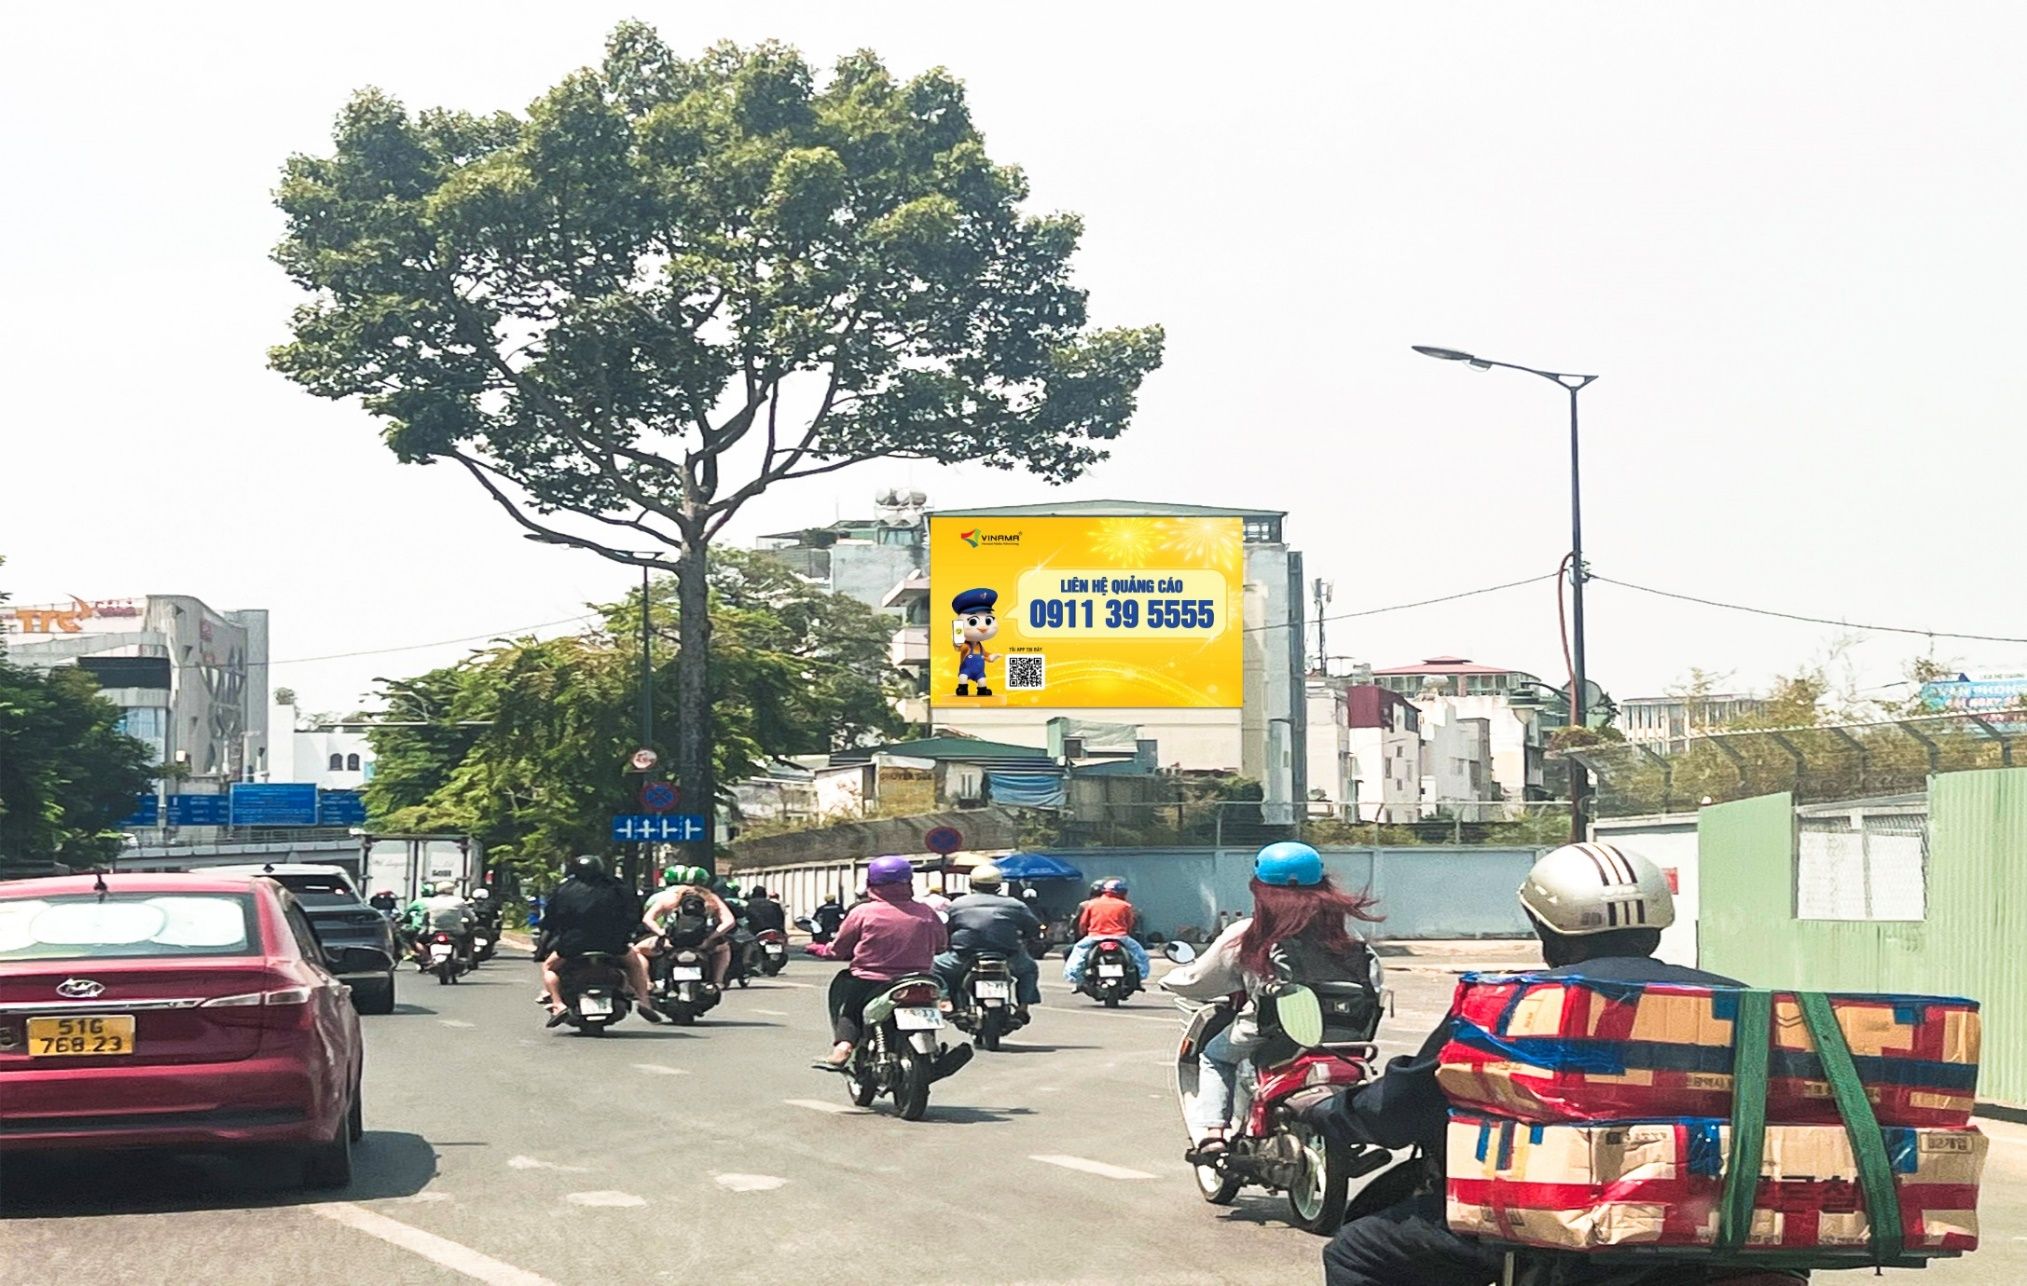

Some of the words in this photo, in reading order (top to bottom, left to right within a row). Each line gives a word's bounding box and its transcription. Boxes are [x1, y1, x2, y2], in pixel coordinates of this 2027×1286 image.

[1060, 577, 1088, 593] LIÊN
[1092, 577, 1108, 596] HỆ
[1111, 575, 1154, 594] QUẢNG
[1158, 577, 1183, 593] CÁO
[1030, 599, 1093, 628] 0911
[1105, 599, 1139, 628] 39
[1147, 599, 1214, 628] 5555
[58, 1018, 104, 1035] 51G
[40, 1036, 122, 1053] 768.23
